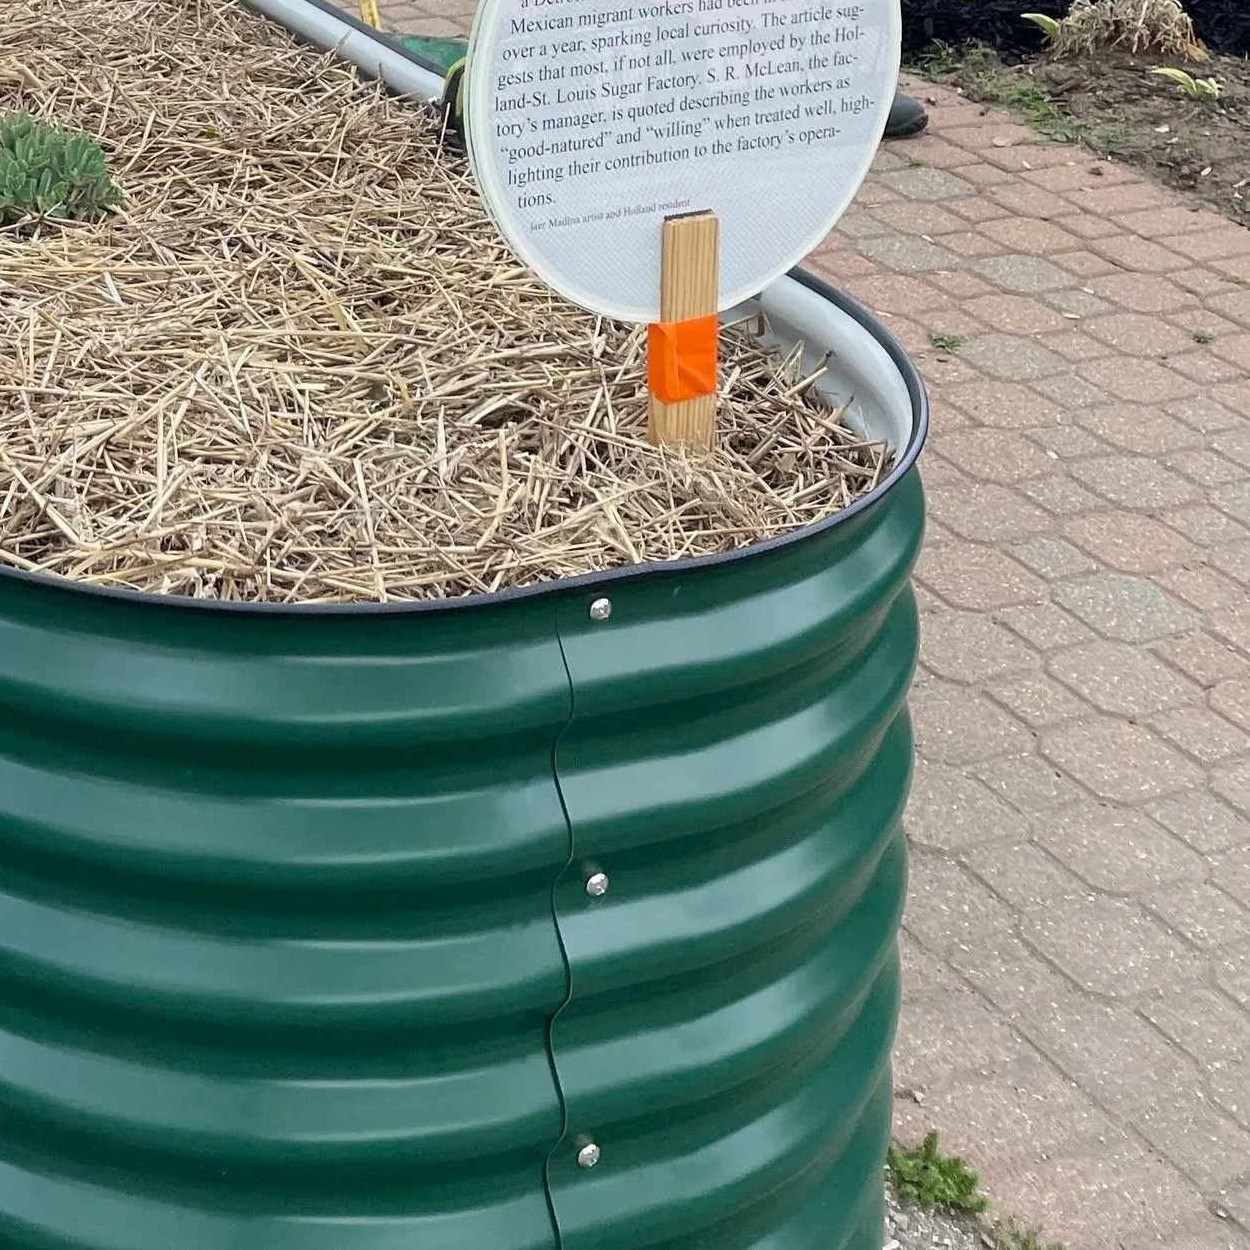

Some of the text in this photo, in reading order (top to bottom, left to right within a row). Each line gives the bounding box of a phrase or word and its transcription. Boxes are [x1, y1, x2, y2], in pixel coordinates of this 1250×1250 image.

[502, 6, 864, 61] over a year, sparking local curiosity. The article sug-
[510, 14, 573, 35] Mexican
[578, 6, 634, 28] migrant
[637, 0, 694, 19] workers
[495, 51, 858, 112] land-St. Louis Sugar Factory. S. R. McLean, the fac-
[497, 25, 864, 91] gests that most, if not all, were employed by the Hol-
[542, 111, 607, 131] manager,
[612, 105, 623, 121] is
[627, 97, 675, 123] quoted
[679, 89, 750, 112] describing
[755, 85, 775, 101] the
[779, 79, 832, 97] workers
[836, 78, 850, 90] as
[616, 126, 641, 145] and
[714, 113, 750, 130] when
[755, 104, 800, 125] treated
[804, 99, 836, 117] well,
[841, 95, 875, 114] high-
[508, 165, 564, 188] lighting
[568, 157, 601, 176] their
[605, 146, 689, 171] contribution
[694, 145, 707, 157] to
[712, 139, 732, 155] the
[799, 127, 841, 145] opera-
[518, 192, 556, 209] tions.
[605, 207, 621, 219] and
[623, 202, 656, 217] Holland
